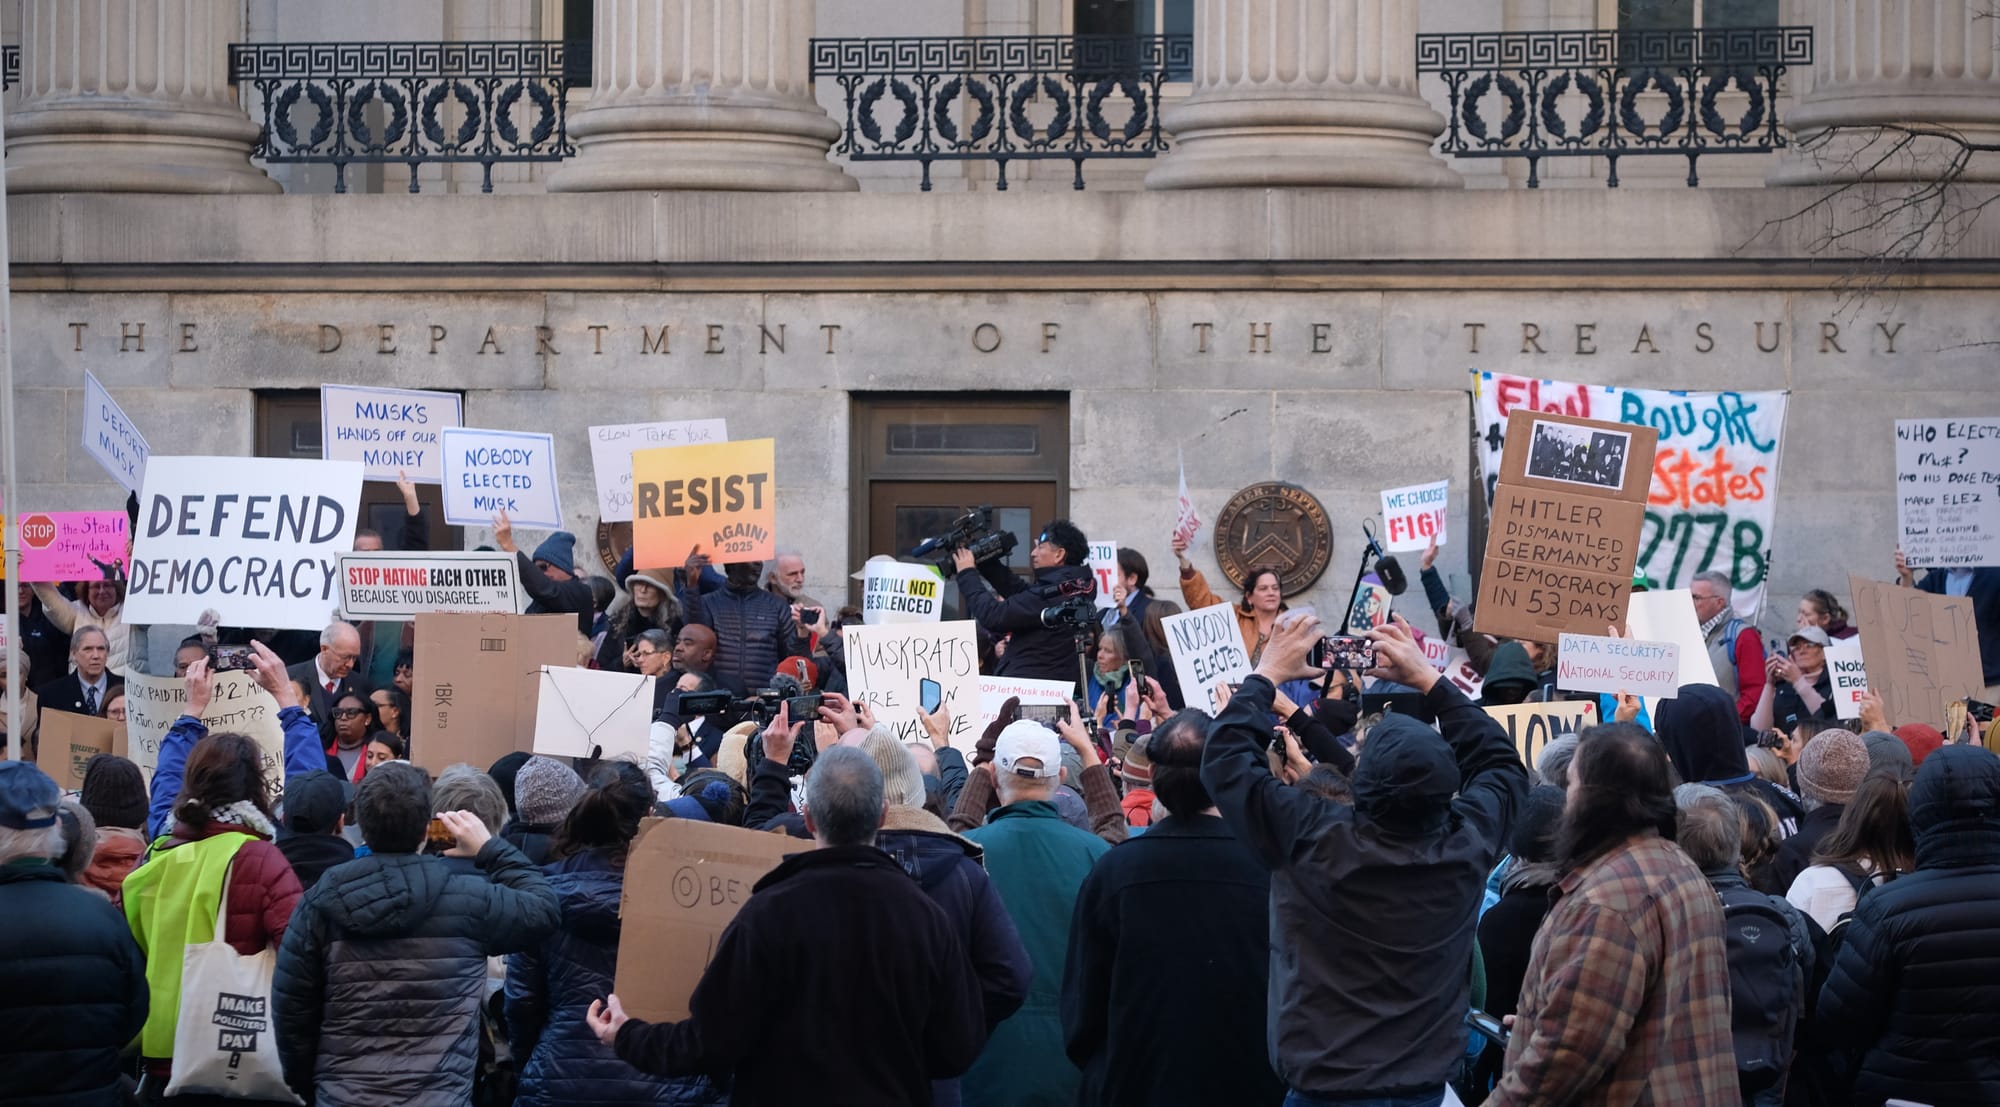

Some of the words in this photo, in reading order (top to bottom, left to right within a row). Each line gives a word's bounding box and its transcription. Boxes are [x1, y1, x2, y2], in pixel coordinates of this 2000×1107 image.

[68, 322, 199, 354] THE
[317, 322, 842, 354] DEPARTMENT
[971, 322, 1061, 354] OF
[1191, 322, 1333, 354] THE
[1463, 322, 1907, 354] TREASURY
[355, 401, 429, 425] MUSK'S
[1619, 389, 1776, 454] Bought
[101, 404, 145, 464] DEPORT
[336, 426, 381, 442] HANDS
[386, 429, 407, 442] OFF
[412, 431, 438, 444] OUR
[1897, 424, 1937, 443] WHO
[99, 431, 137, 481] MUSK
[363, 449, 424, 468] MONEY
[465, 447, 534, 467] NOBODY
[462, 472, 532, 490] ELECTED
[1647, 446, 1767, 510] States
[473, 495, 519, 513] MUSK
[637, 472, 768, 519] RESIST
[1386, 493, 1406, 510] WE
[146, 493, 346, 545] DEFEND
[1510, 495, 1603, 528] HITLER
[24, 523, 55, 539] STOP
[62, 523, 79, 536] the
[712, 522, 769, 548] AGAIN!
[1506, 521, 1623, 553] DISMANTLED
[724, 541, 753, 553] 2025
[1501, 540, 1621, 572] GERMANY'S
[128, 555, 337, 601] DEMOCRACY
[348, 567, 381, 586] STOP
[383, 567, 428, 587] HATING
[430, 568, 463, 587] EACH
[465, 568, 508, 587] OTHER
[867, 576, 879, 592] WE
[880, 577, 905, 594] WILL
[909, 579, 936, 598] NOT
[1496, 561, 1623, 599] DEMOCRACY
[350, 589, 400, 604] BECAUSE
[401, 590, 424, 605] YOU
[866, 594, 874, 610] BE
[875, 594, 933, 615] SILENCED
[1492, 586, 1517, 607] IN
[1526, 590, 1561, 616] 53
[1569, 599, 1620, 622] DAYS
[1171, 609, 1233, 656] NOBODY
[1563, 638, 1600, 654] DATA
[1607, 643, 1667, 659] SECURITY
[848, 631, 975, 690] MUSKRATS
[1193, 644, 1244, 685] ELECTED
[1558, 660, 1614, 680] NATIONAL
[1619, 665, 1675, 683] SECURITY
[148, 687, 172, 703] PAID
[434, 682, 453, 707] 1BK
[857, 690, 901, 708] ARE
[1012, 686, 1039, 697] Musk
[220, 996, 265, 1014] MAKE
[213, 1013, 266, 1031] POLLUTERS
[221, 1033, 255, 1049] PAY
